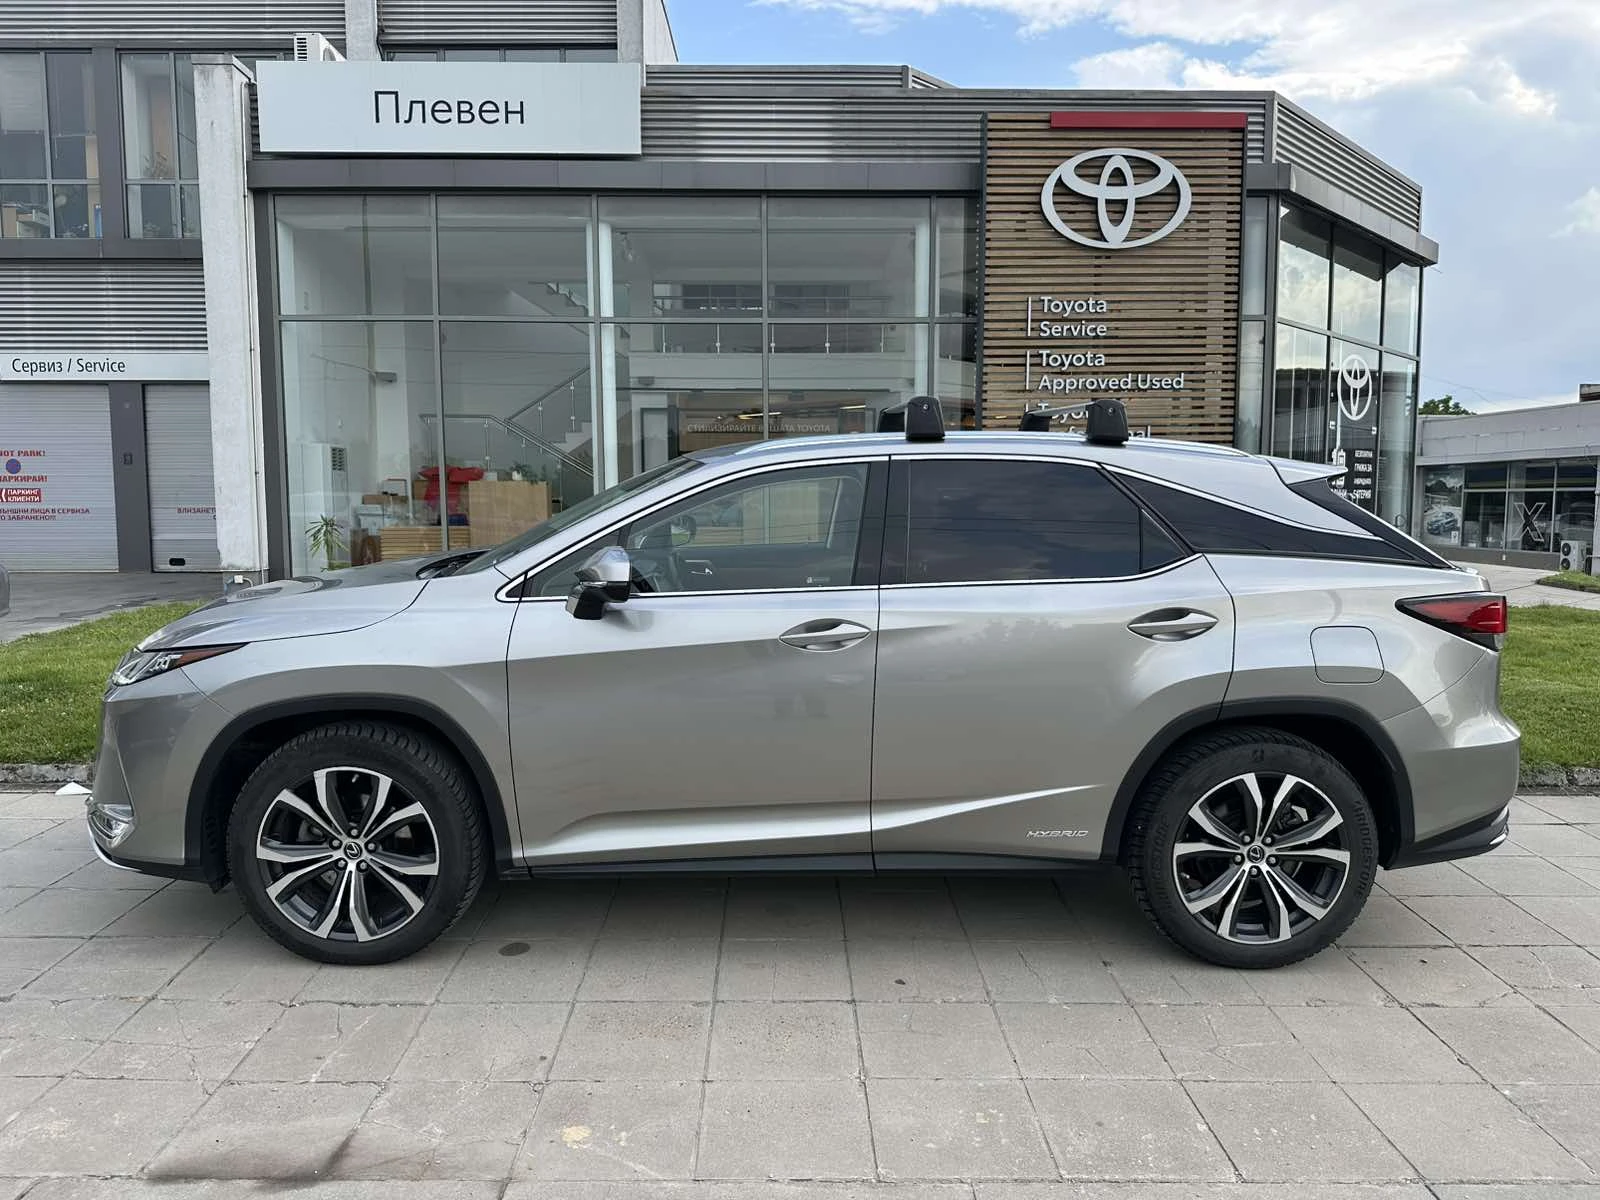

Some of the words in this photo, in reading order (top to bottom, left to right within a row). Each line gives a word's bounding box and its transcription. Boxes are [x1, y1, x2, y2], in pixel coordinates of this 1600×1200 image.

[374, 90, 525, 124] Плевен
[1040, 296, 1107, 317] Toyota
[1039, 320, 1107, 337] Service
[11, 357, 63, 376] Сервиз
[76, 357, 126, 373] Service
[1038, 350, 1105, 370] Toyota
[1038, 373, 1132, 394] Approved
[1137, 372, 1185, 389] Used
[1026, 830, 1089, 838] HYBRID
